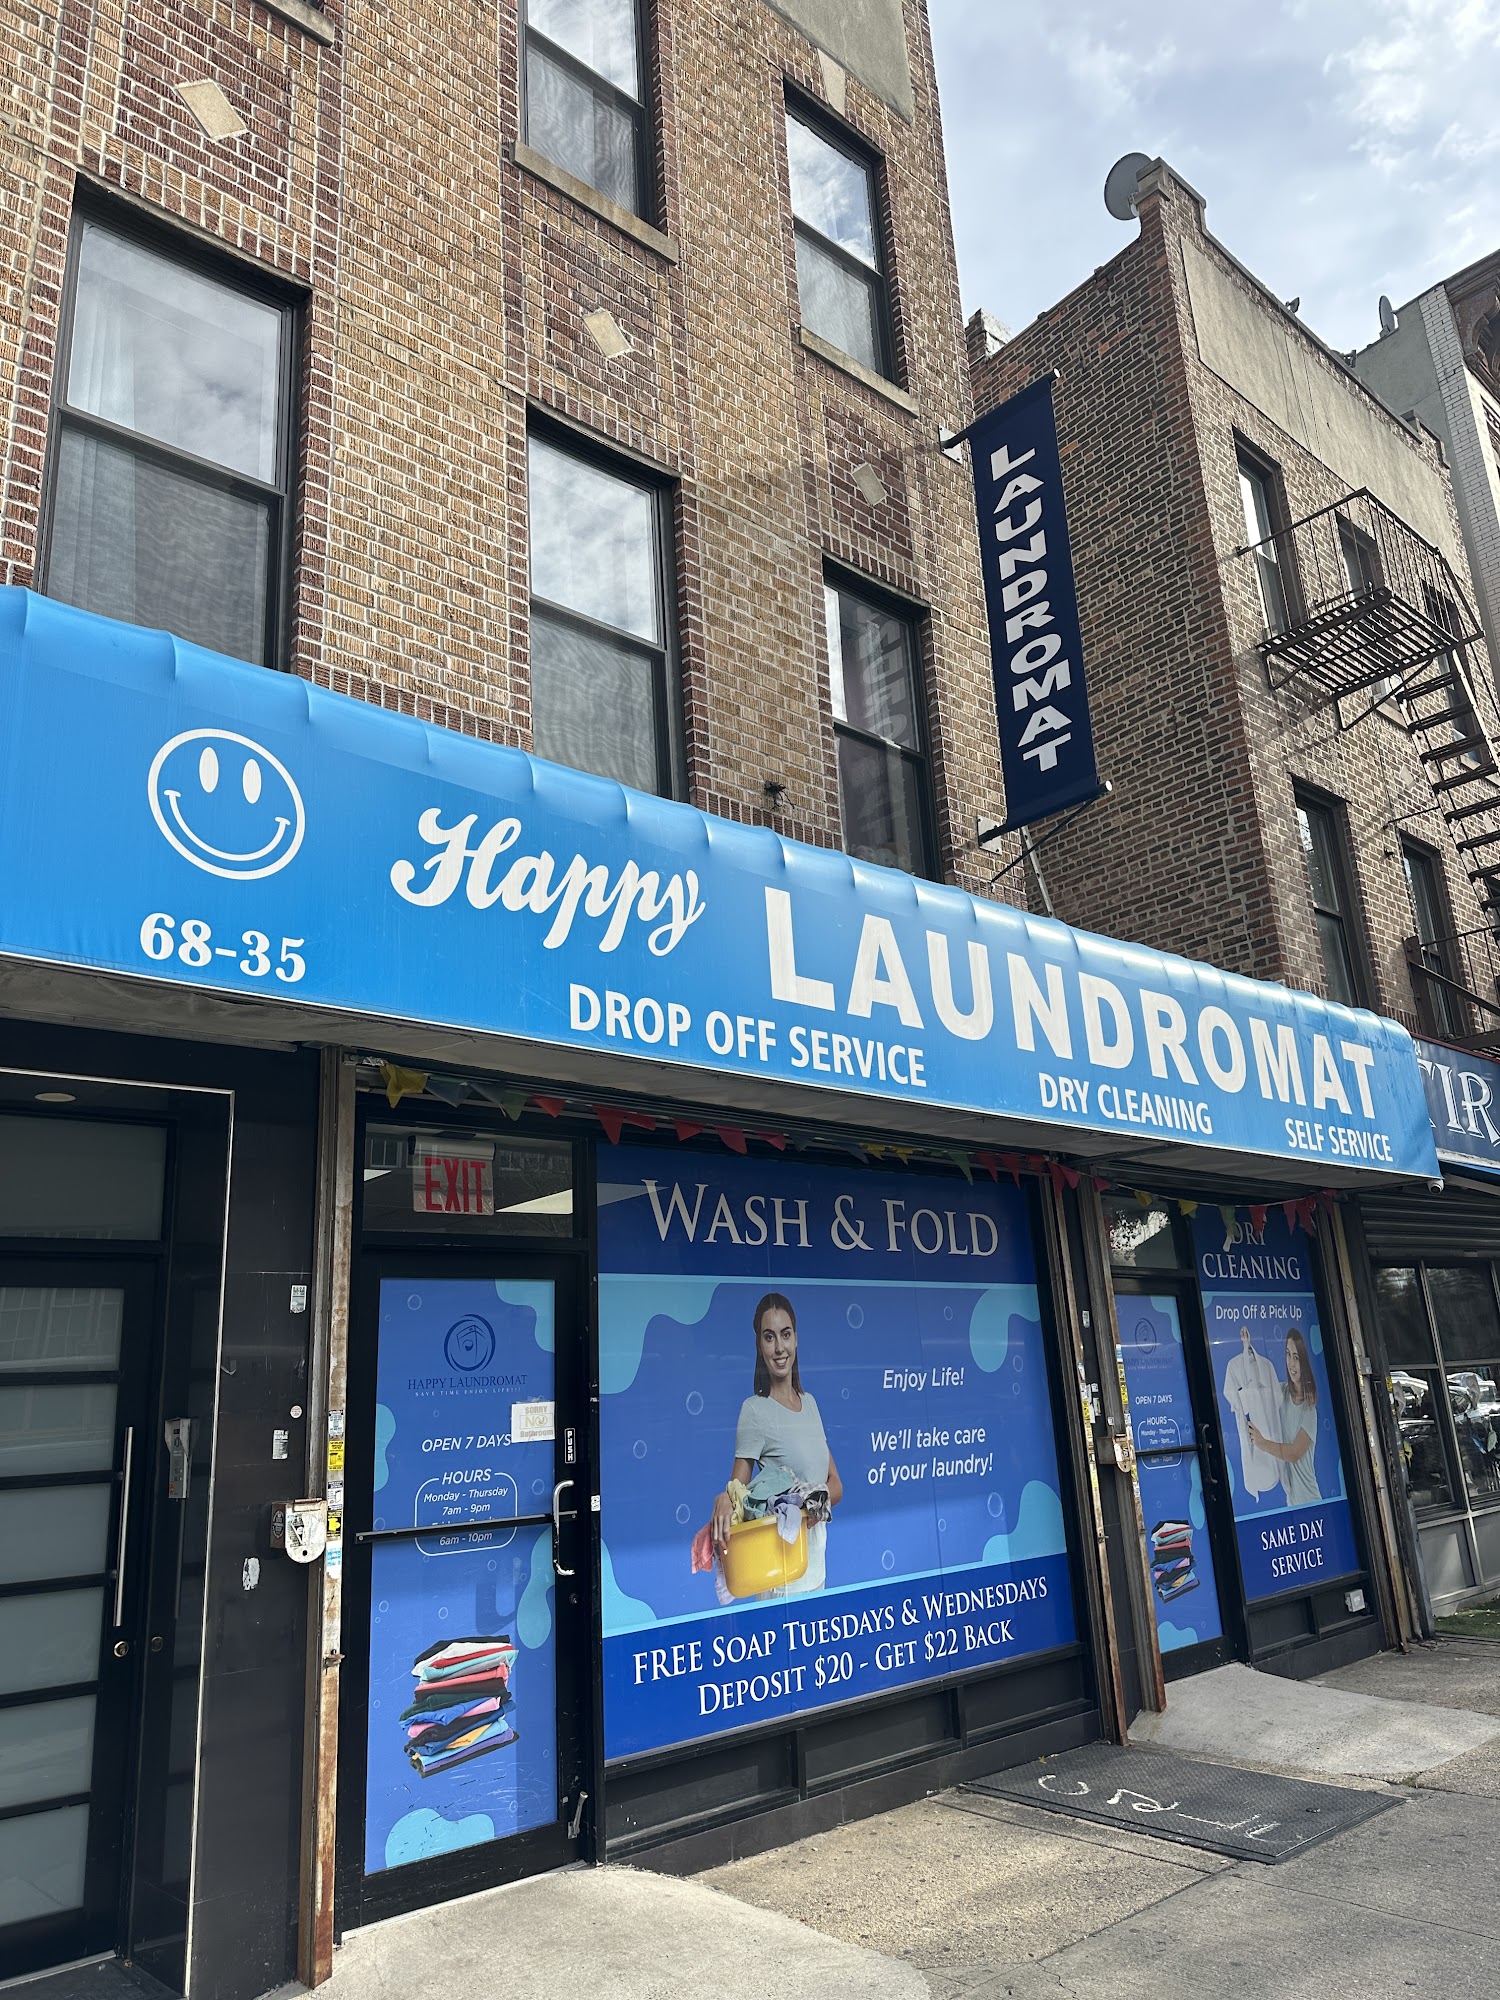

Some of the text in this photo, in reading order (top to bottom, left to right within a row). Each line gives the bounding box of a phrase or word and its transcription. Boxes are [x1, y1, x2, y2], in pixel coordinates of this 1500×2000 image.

[990, 444, 1072, 772] LAUNDROMAT
[390, 807, 706, 957] Happy
[139, 912, 307, 983] 68-35
[764, 886, 1376, 1119] LAUNDROMAT
[569, 983, 927, 1087] DROP OFF SERVICE
[1038, 1072, 1213, 1135] DRY CLEANING
[1284, 1117, 1394, 1162] SELF SERVICE
[424, 1158, 487, 1213] EXIT
[830, 1194, 874, 1251] &
[1202, 1253, 1300, 1280] CLEANING
[1215, 1304, 1302, 1322] Drop Off & Pick Up
[408, 1374, 528, 1390] HAPPY LAUNDROMAT
[883, 1366, 965, 1392] Enjoy Life!
[524, 1405, 548, 1414] SORRY
[1135, 1394, 1173, 1405] OPEN 7 DAYS
[520, 1429, 553, 1438] Bathroom
[1146, 1416, 1168, 1426] HOURS
[421, 1433, 512, 1452] OPEN 7 DAYS
[566, 1430, 574, 1461] PUSH
[916, 1426, 950, 1448] take
[954, 1427, 986, 1445] care
[442, 1468, 492, 1485] HOURS
[867, 1452, 993, 1486] of your laundry!
[423, 1491, 460, 1502] Monday
[469, 1487, 509, 1499] Thursday
[442, 1506, 461, 1515] 7am
[470, 1503, 491, 1514] 9pm
[439, 1536, 460, 1546] 6am
[468, 1532, 493, 1544] 10pm
[1261, 1519, 1324, 1550] SAME DAY
[1271, 1547, 1324, 1578] SERVICE
[632, 1640, 703, 1685] FREE
[901, 1598, 920, 1626] &
[814, 1651, 854, 1690] $20
[860, 1661, 869, 1669] -
[924, 1628, 959, 1662] $22
